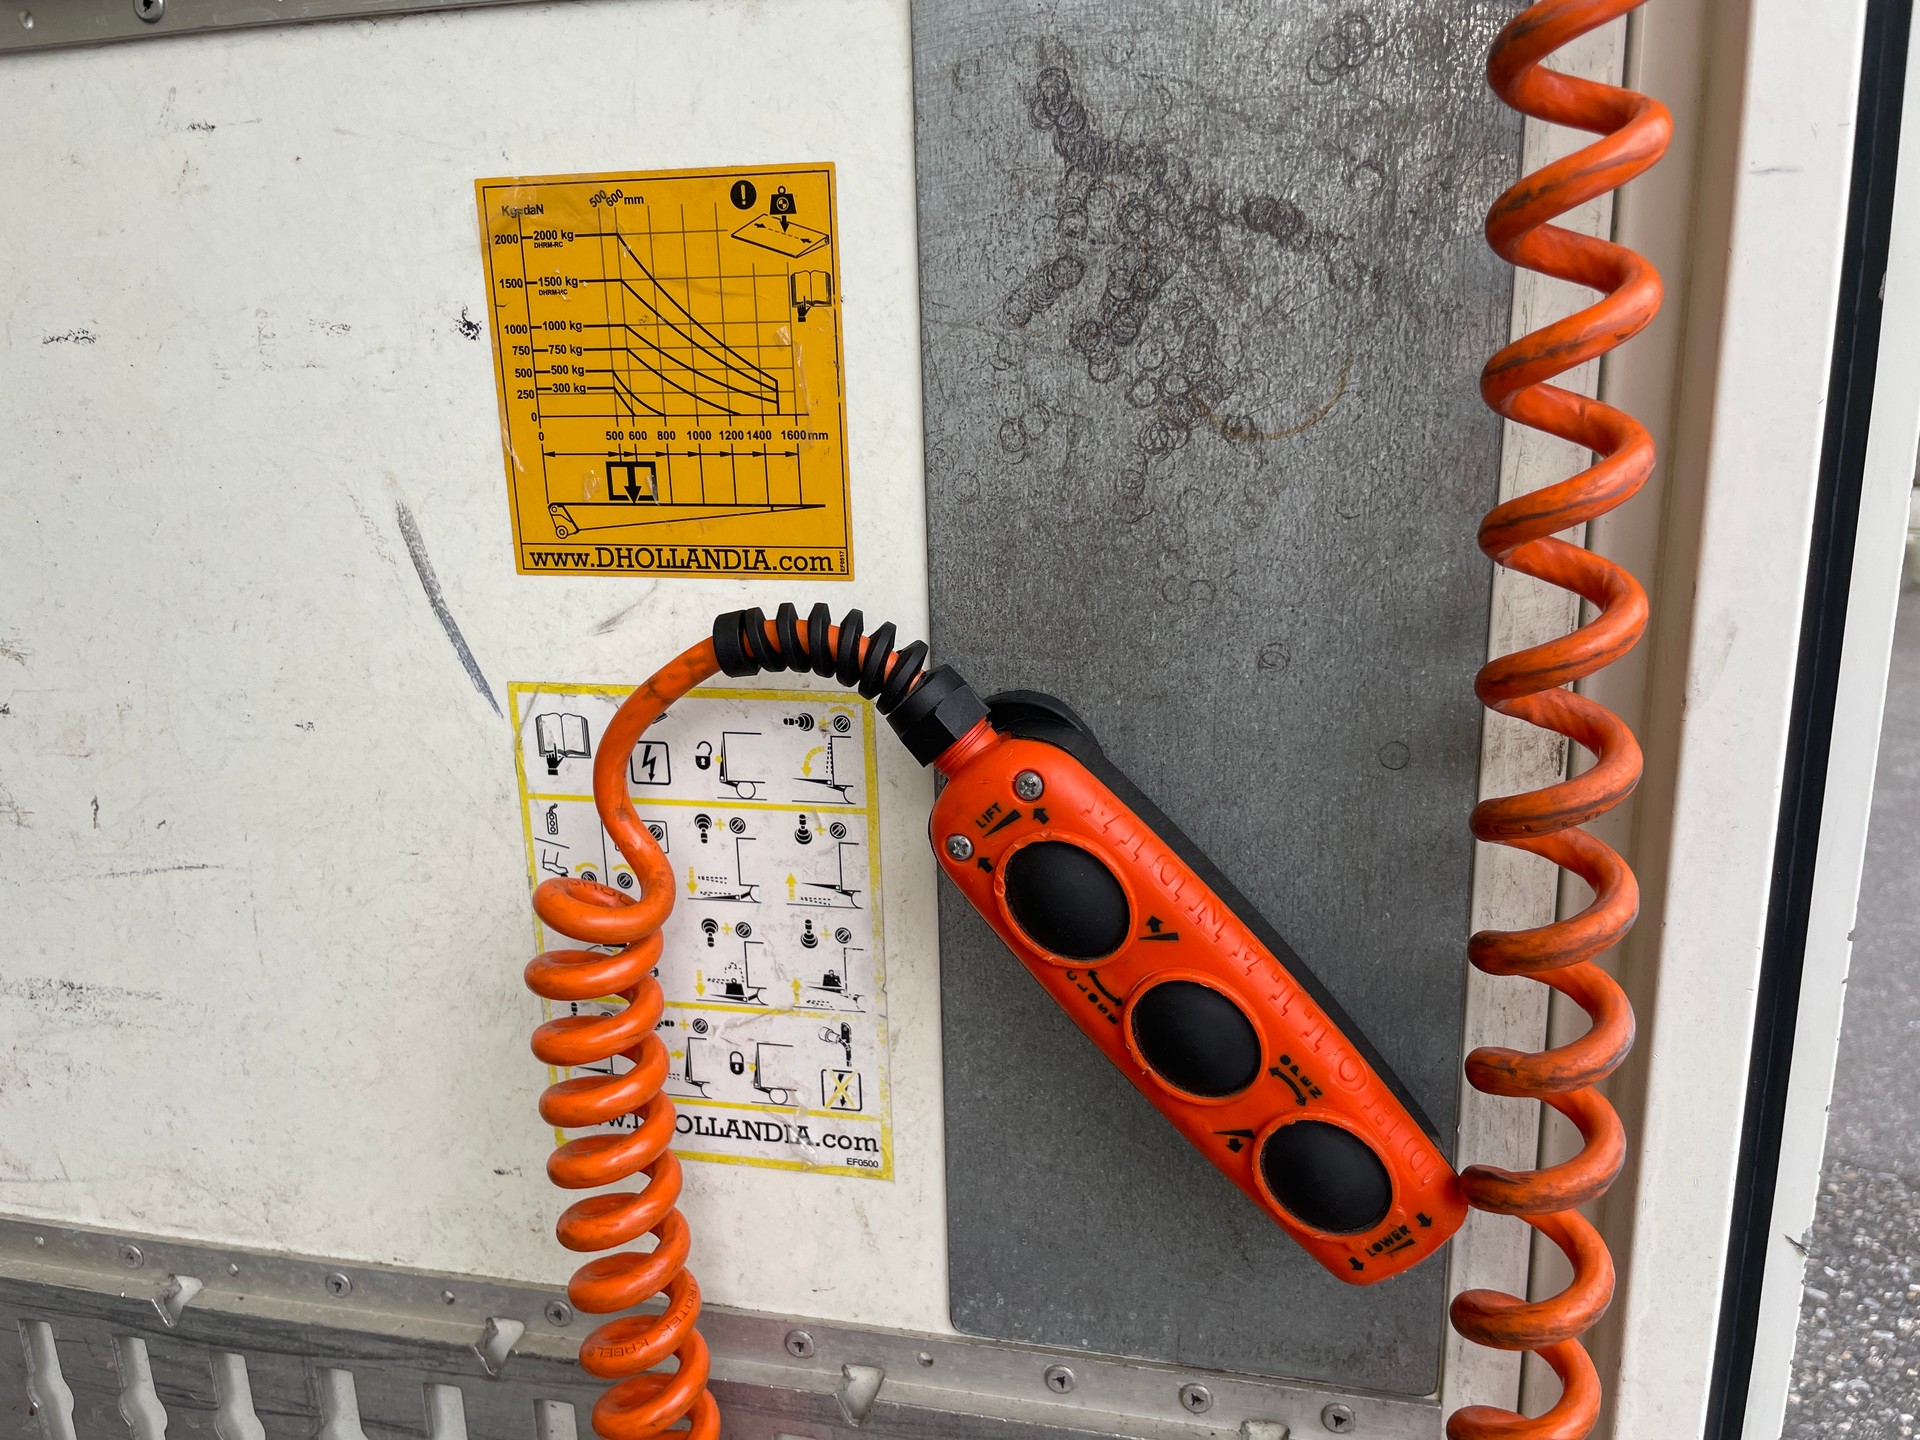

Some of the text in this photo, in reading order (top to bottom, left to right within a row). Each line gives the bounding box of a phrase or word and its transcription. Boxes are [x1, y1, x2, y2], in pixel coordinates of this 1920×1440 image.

[589, 188, 644, 208] 500 600 mm
[494, 234, 519, 245] 2000
[533, 230, 574, 242] 2000 kg
[499, 278, 523, 289] 1500
[538, 276, 579, 288] 1500 kg
[504, 324, 528, 335] 1000
[542, 320, 583, 333] 1000 kg
[512, 346, 531, 356] 750
[548, 344, 583, 356] 750 kg
[515, 368, 533, 378] 500
[551, 365, 585, 377] 500 kg
[552, 383, 586, 394] 300 kg
[517, 390, 535, 400] 250
[531, 412, 538, 422] 0
[538, 430, 829, 441] 0 500 600 800 1000 1200 1400 1600 mm
[530, 547, 834, 572] www.DHOLLANDIA.com
[975, 802, 1002, 829] LIFT
[1066, 970, 1119, 1024] CLOSE
[1279, 1054, 1324, 1099] OPEN
[846, 1158, 879, 1168] EF0500
[1365, 1224, 1412, 1257] LOWER
